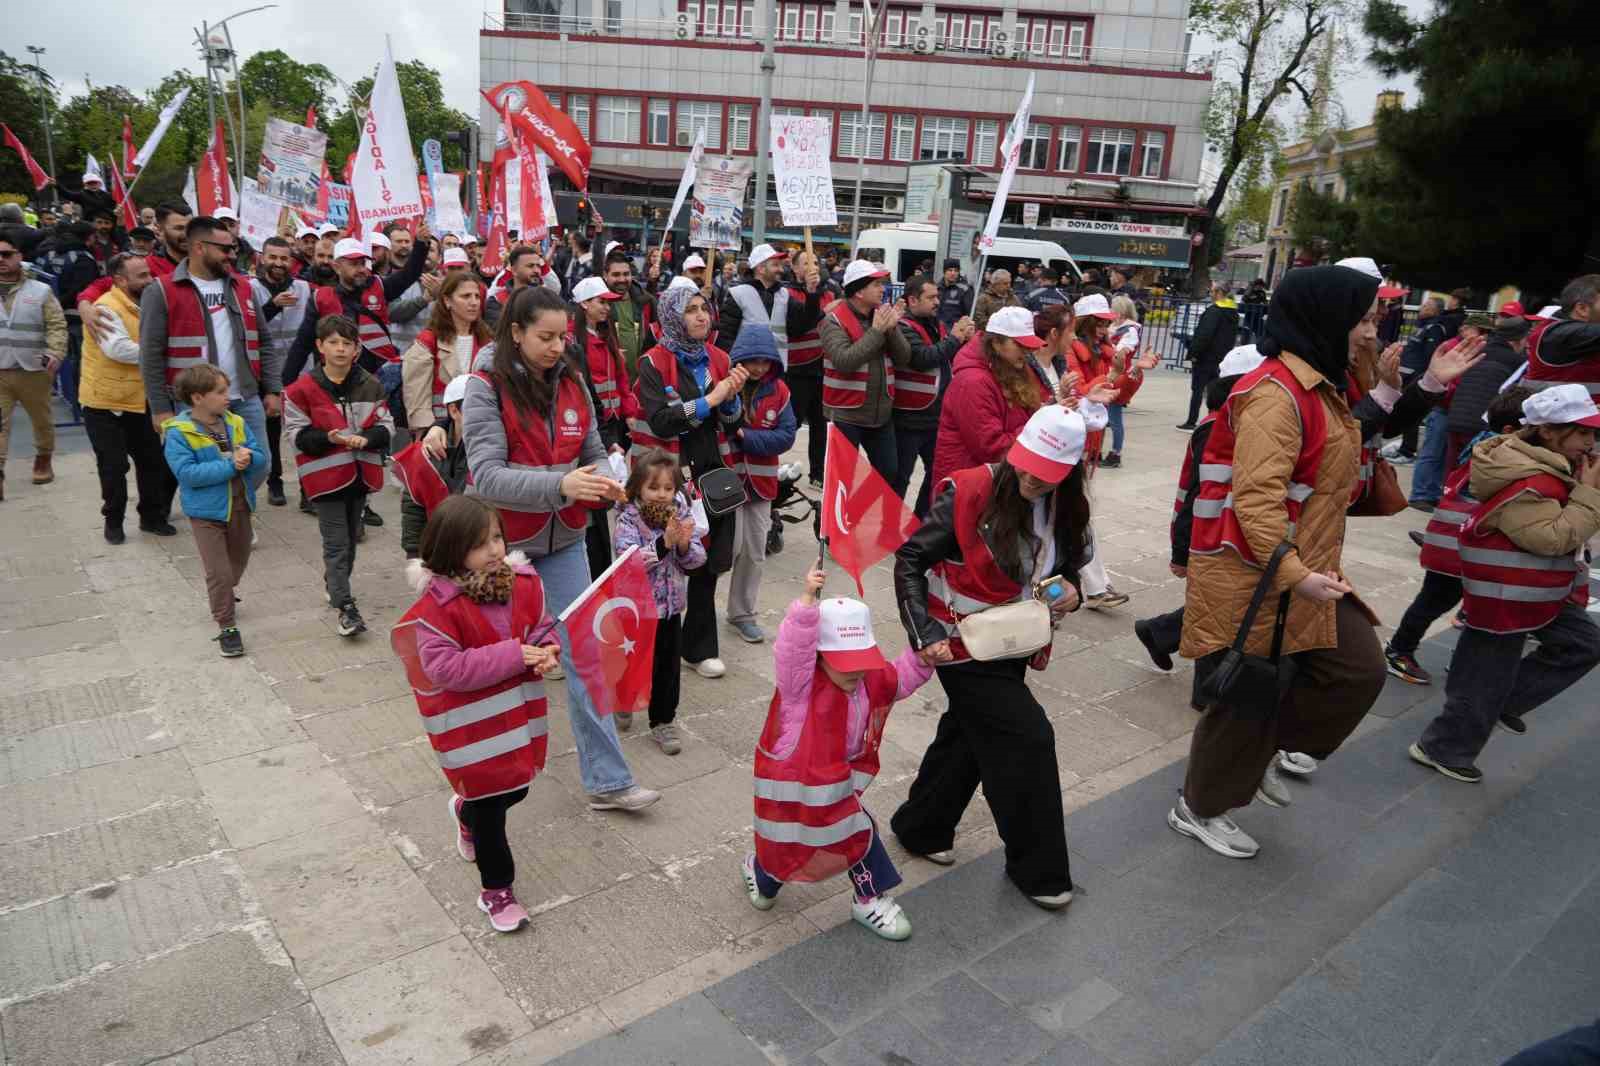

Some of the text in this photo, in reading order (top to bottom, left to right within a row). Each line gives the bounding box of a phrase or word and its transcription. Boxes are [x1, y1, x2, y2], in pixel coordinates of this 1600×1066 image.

[1067, 220, 1092, 229] DOYA
[1094, 222, 1119, 231] DOYA
[1120, 224, 1152, 234] TAVUK
